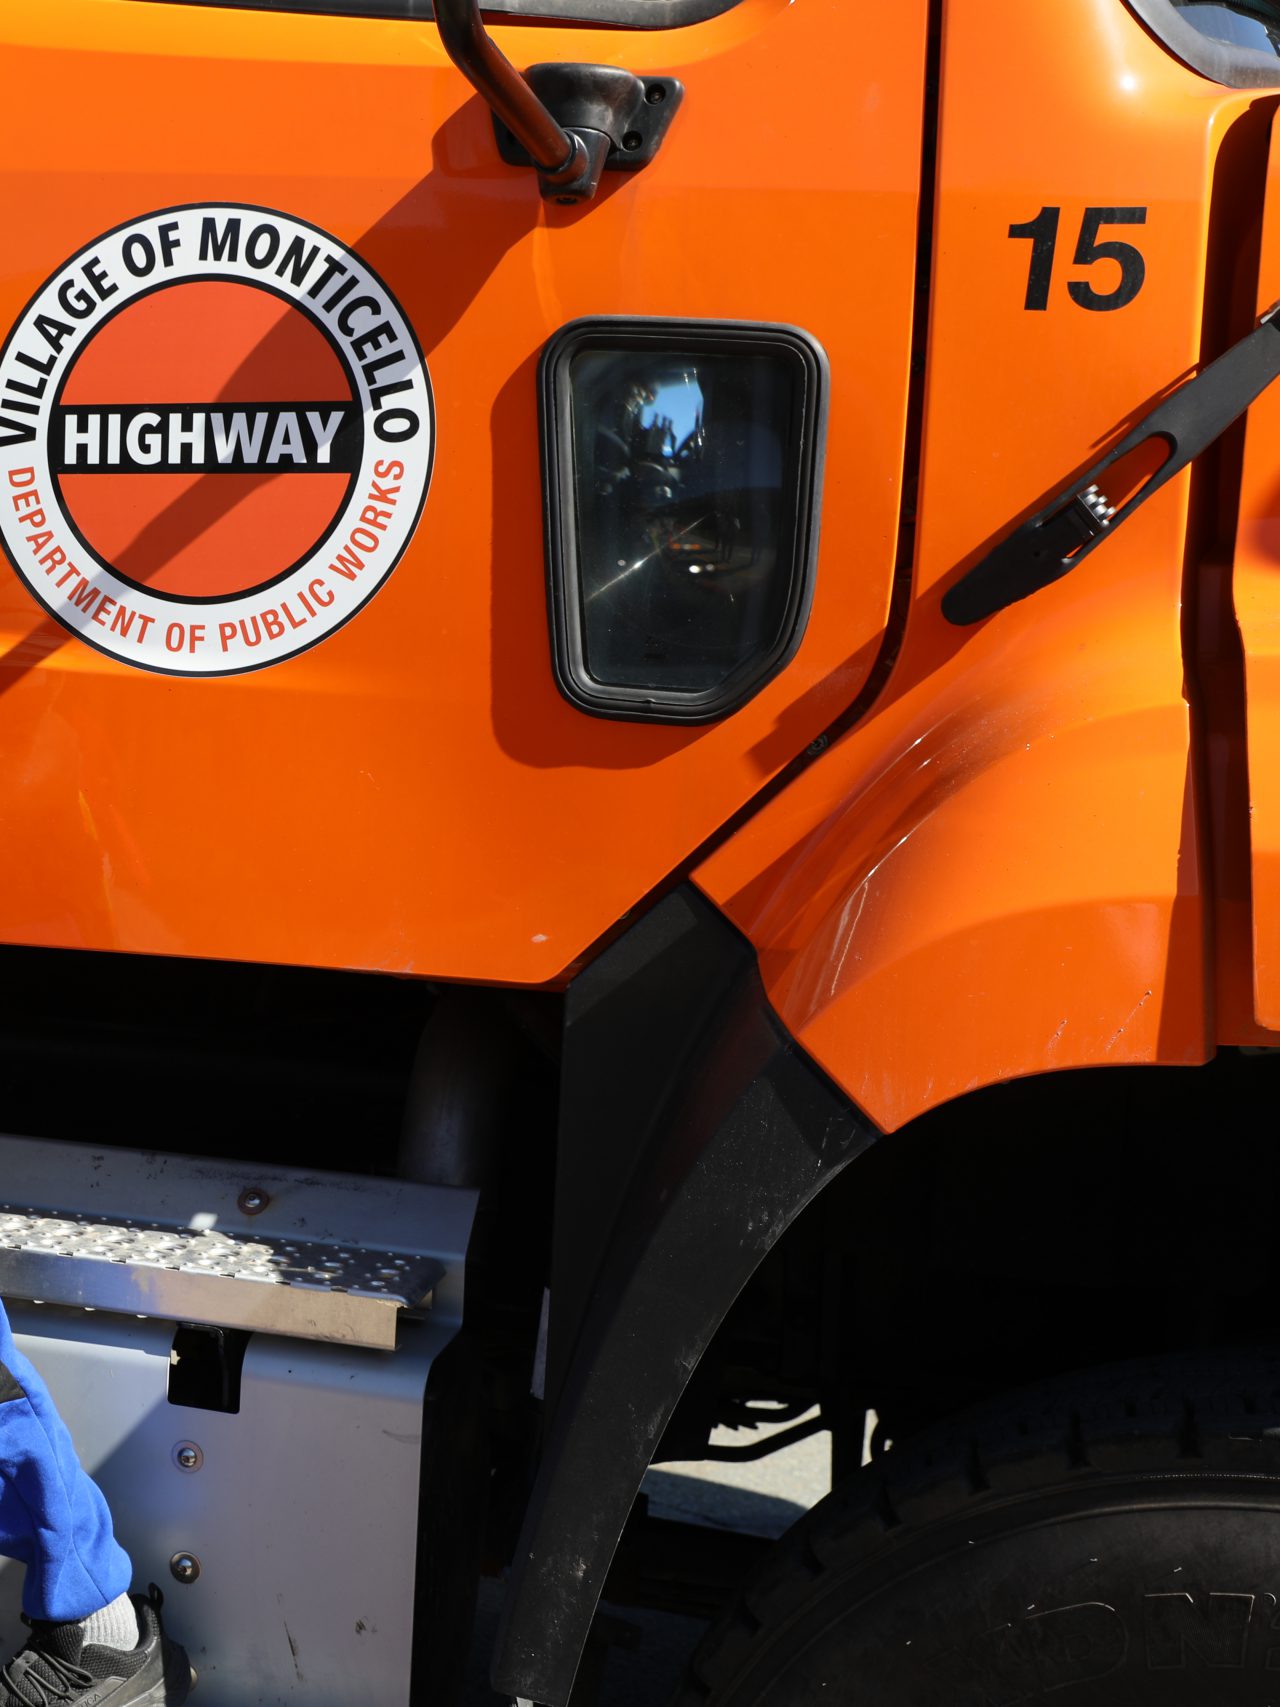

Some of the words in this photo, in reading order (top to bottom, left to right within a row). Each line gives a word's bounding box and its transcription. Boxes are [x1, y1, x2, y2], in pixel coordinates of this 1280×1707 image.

[122, 221, 182, 278] OF
[198, 217, 420, 443] MONTICELLO
[1007, 206, 1148, 312] 15
[64, 411, 345, 466] HIGHWAY
[7, 466, 156, 645] DEPARTMENT
[165, 621, 206, 654] OF
[218, 578, 336, 653] PUBLIC
[328, 458, 405, 582] WORKS
